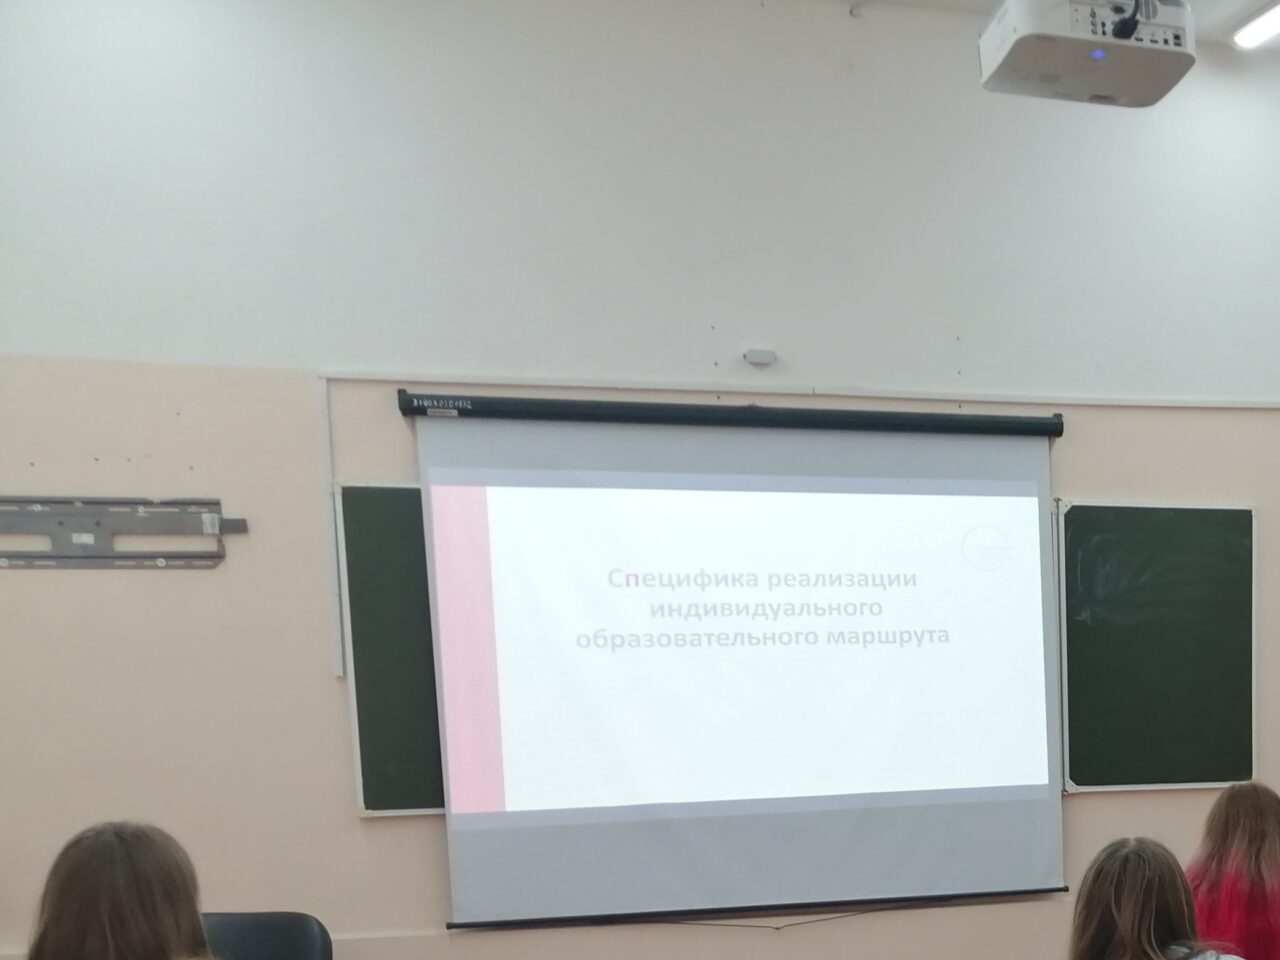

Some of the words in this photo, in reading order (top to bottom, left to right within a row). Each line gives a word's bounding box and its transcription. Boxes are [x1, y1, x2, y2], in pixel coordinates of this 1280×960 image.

[607, 567, 760, 593] Специфика
[768, 570, 918, 592] реализации
[650, 599, 883, 621] индивидуального
[576, 627, 819, 653] образовательного
[827, 626, 950, 650] маршрута
